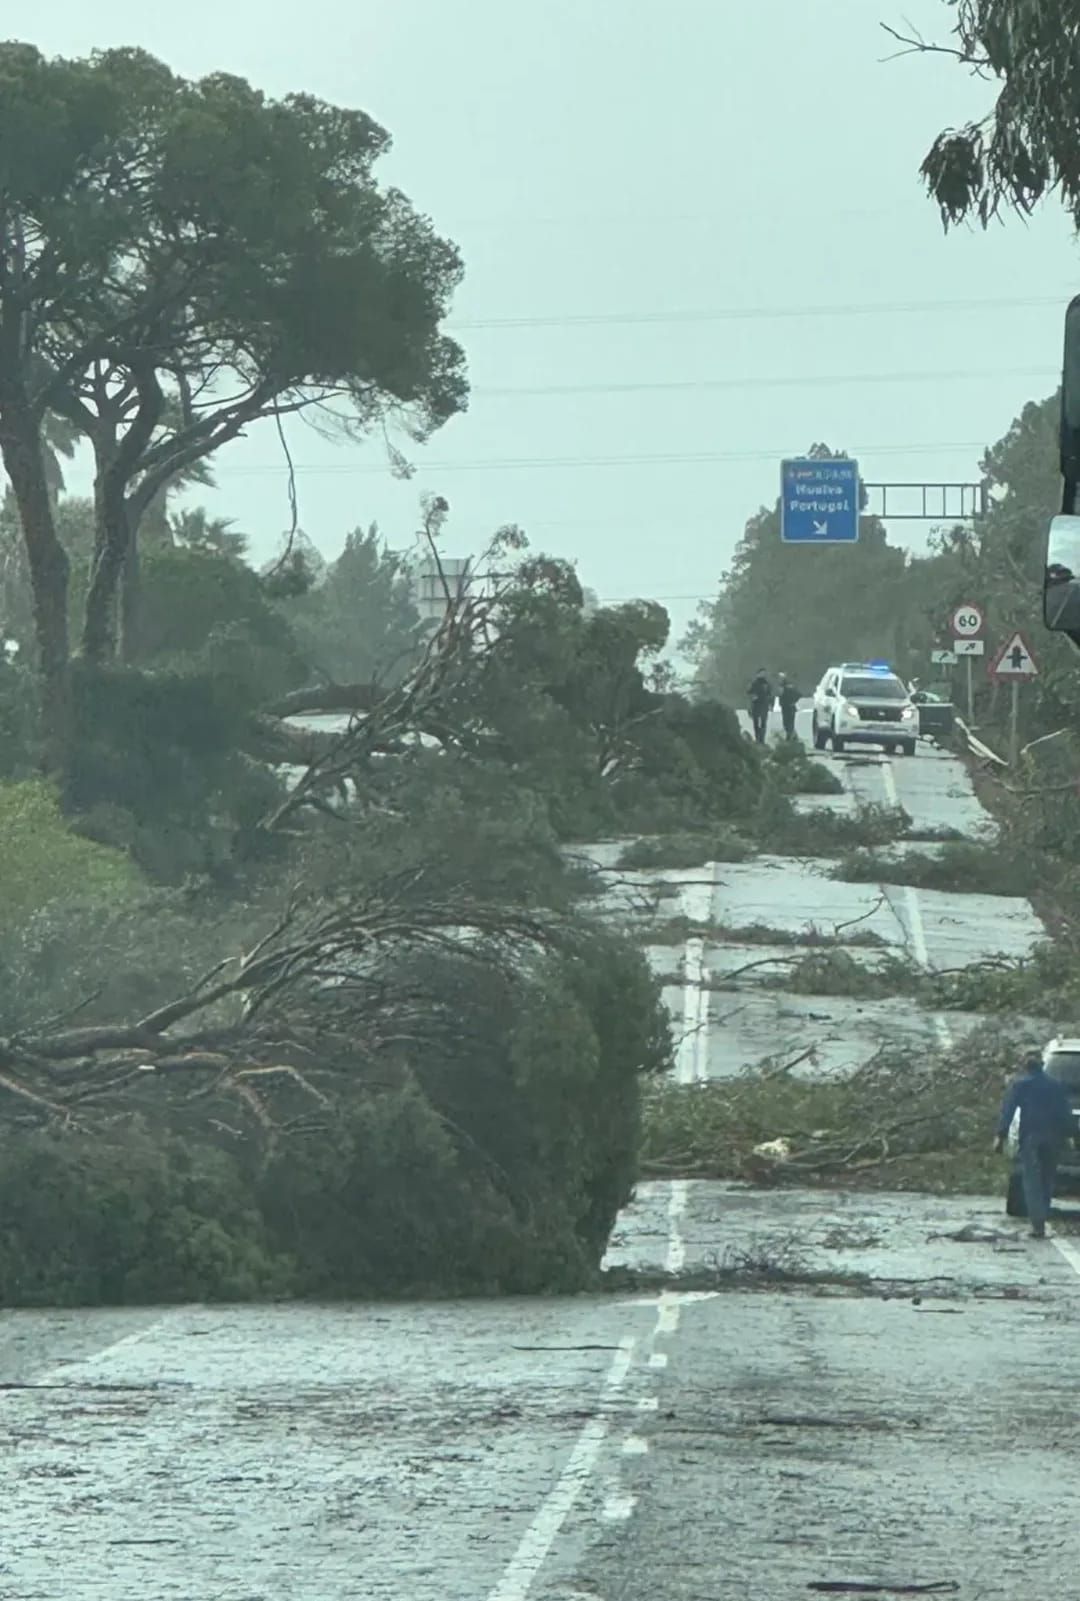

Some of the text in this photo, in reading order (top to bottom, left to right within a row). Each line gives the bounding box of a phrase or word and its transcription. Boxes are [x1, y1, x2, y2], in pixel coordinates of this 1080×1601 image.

[795, 484, 843, 495] Huelva
[790, 499, 850, 513] Portugal
[959, 614, 978, 627] 60
